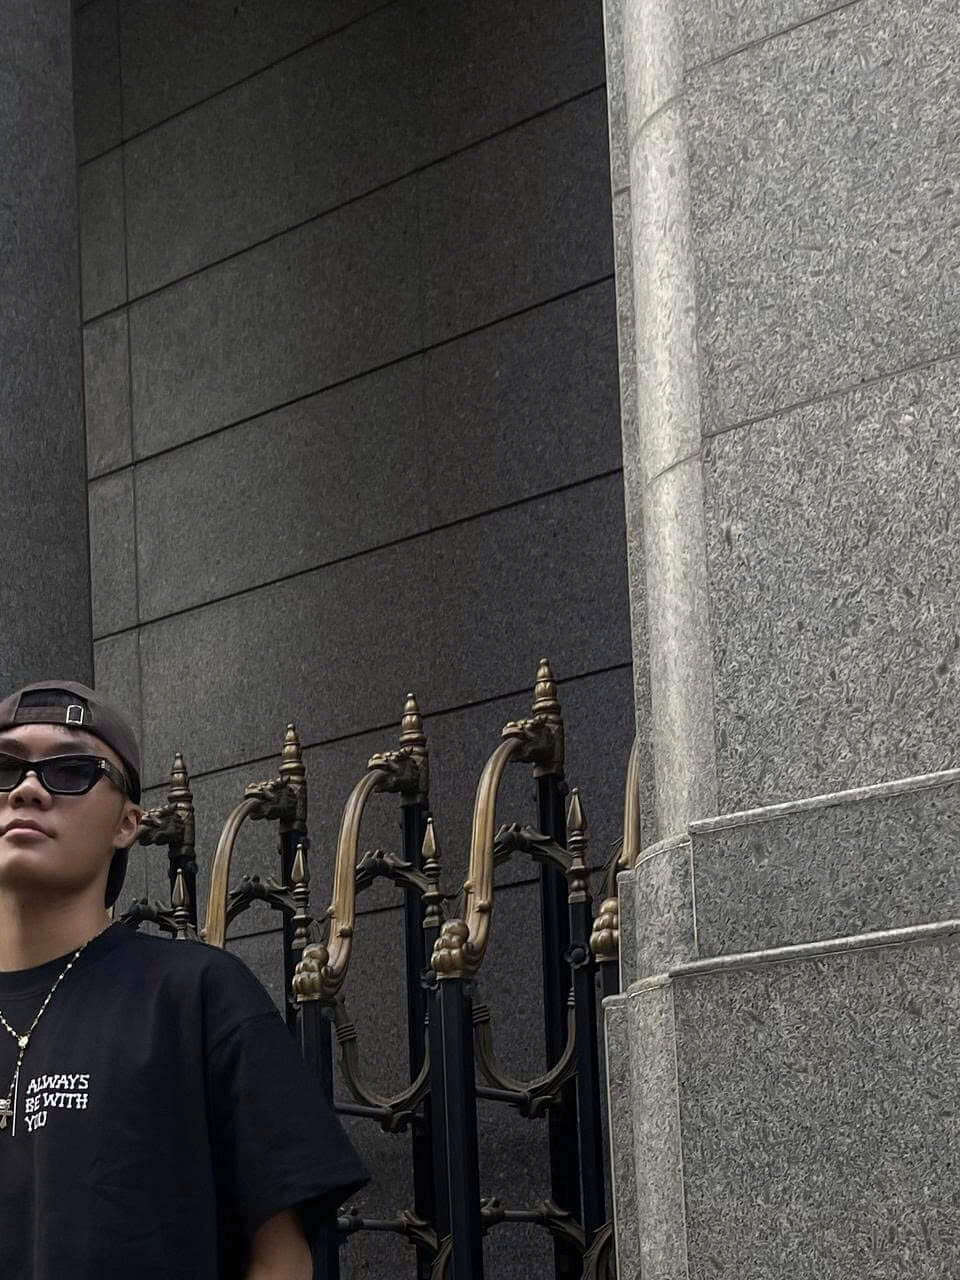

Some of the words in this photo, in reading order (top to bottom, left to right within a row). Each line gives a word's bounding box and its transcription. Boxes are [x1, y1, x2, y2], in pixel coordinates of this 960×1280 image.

[26, 1074, 90, 1095] ALWAYS
[25, 1094, 40, 1113] BE
[42, 1092, 89, 1109] WITH
